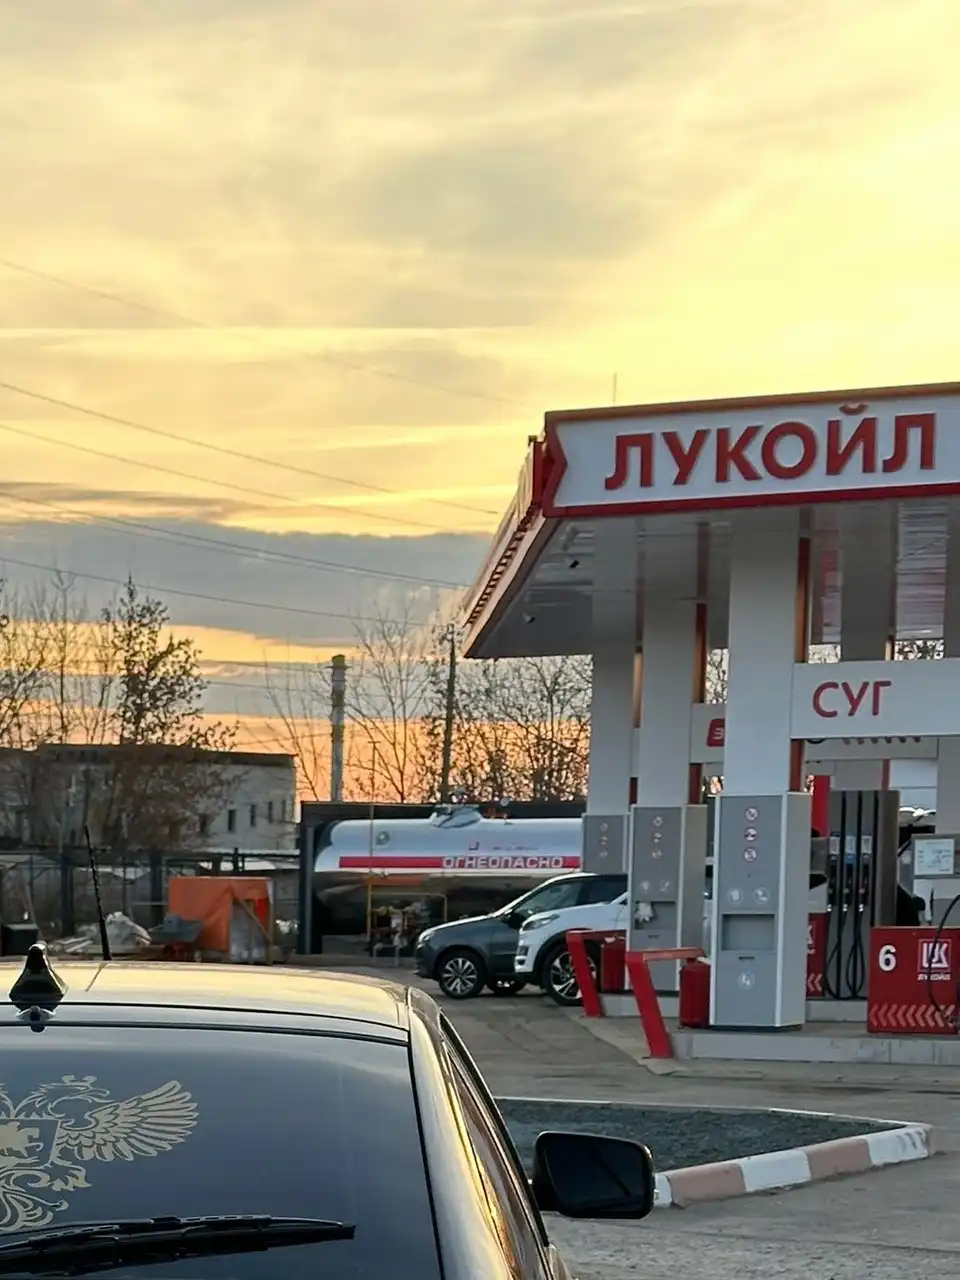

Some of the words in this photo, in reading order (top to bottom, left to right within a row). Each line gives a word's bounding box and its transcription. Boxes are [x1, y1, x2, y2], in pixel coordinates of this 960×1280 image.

[604, 402, 937, 492] ЛУКОЙЛ
[812, 680, 892, 718] СУГ
[442, 856, 564, 869] ОГНЕОПАСНО
[878, 944, 897, 972] 6
